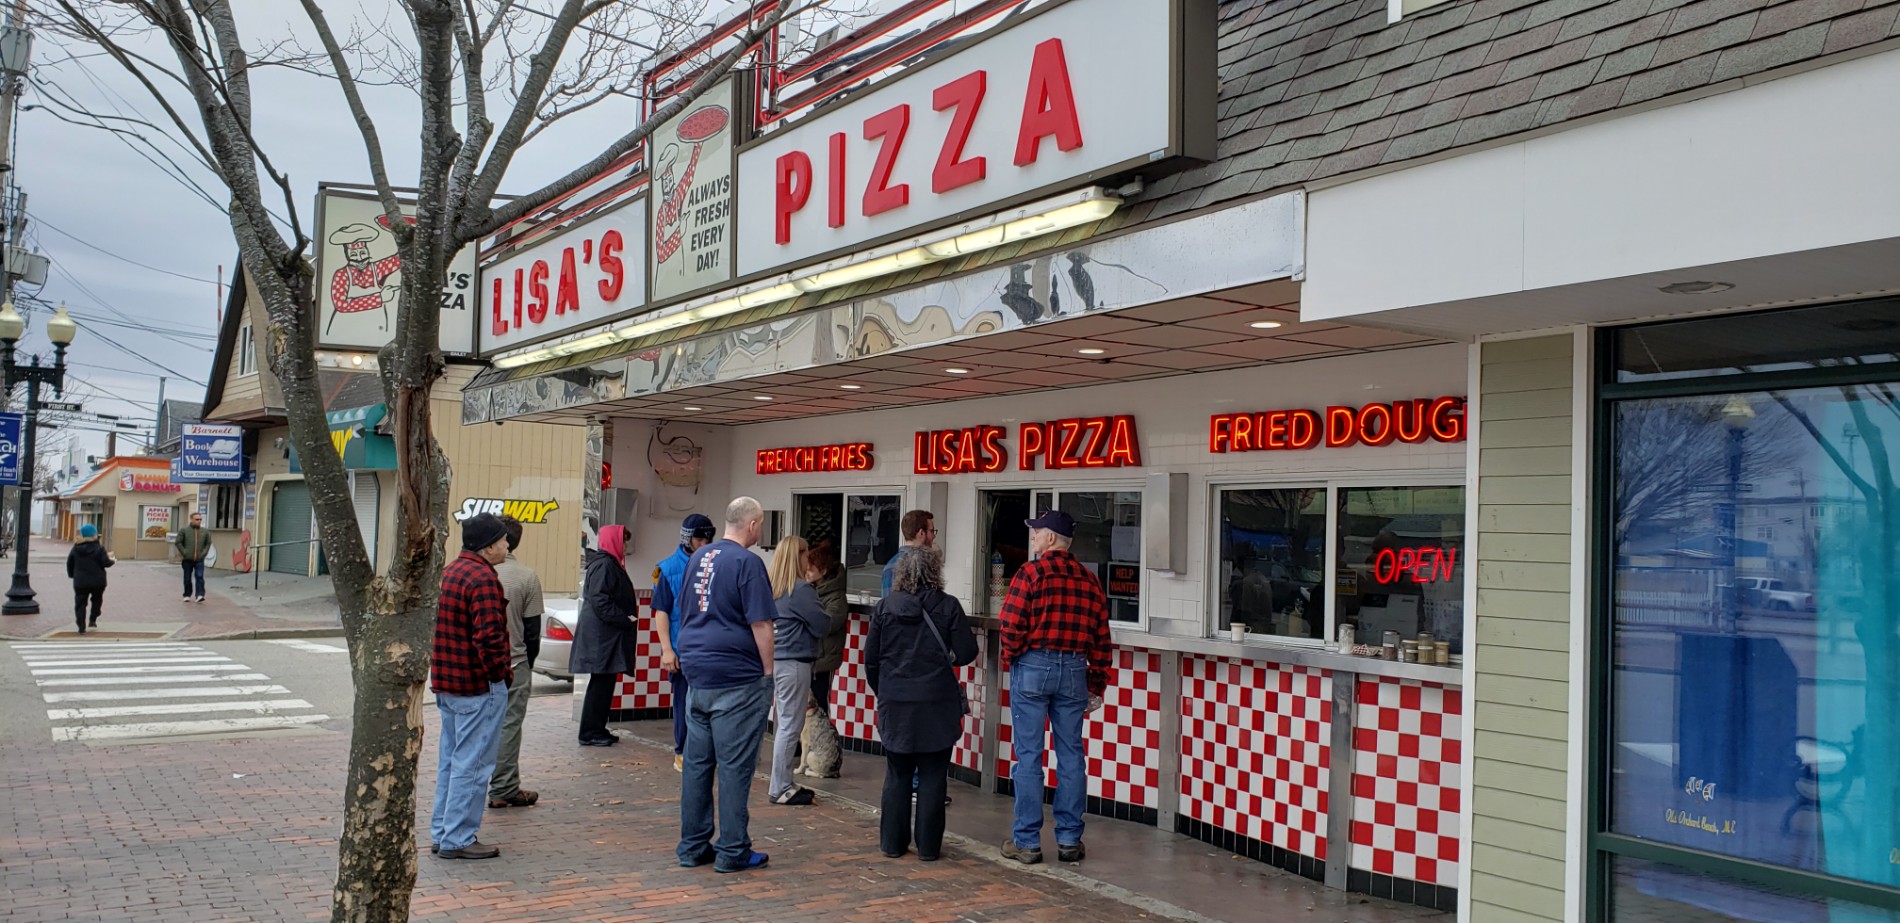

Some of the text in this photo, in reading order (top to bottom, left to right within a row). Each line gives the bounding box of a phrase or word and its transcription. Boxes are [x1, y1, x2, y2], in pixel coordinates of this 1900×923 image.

[775, 37, 1083, 245] PIZZA
[688, 174, 730, 208] ALWAYS
[694, 198, 730, 228] FRESH
[691, 223, 725, 252] EVERY
[696, 249, 719, 272] DAY!
[492, 229, 624, 336] LISA'S
[192, 426, 232, 434] Barnett
[1210, 396, 1467, 453] FRIED DOUG
[185, 439, 213, 451] Book
[757, 443, 874, 474] FRENCH FRIES
[914, 415, 1142, 474] LISA'S PIZZA
[185, 455, 239, 467] Warehouse
[135, 482, 182, 493] DONUTS
[1115, 568, 1134, 579] HELP
[1375, 547, 1456, 584] OPEN
[1110, 581, 1139, 593] WANTED
